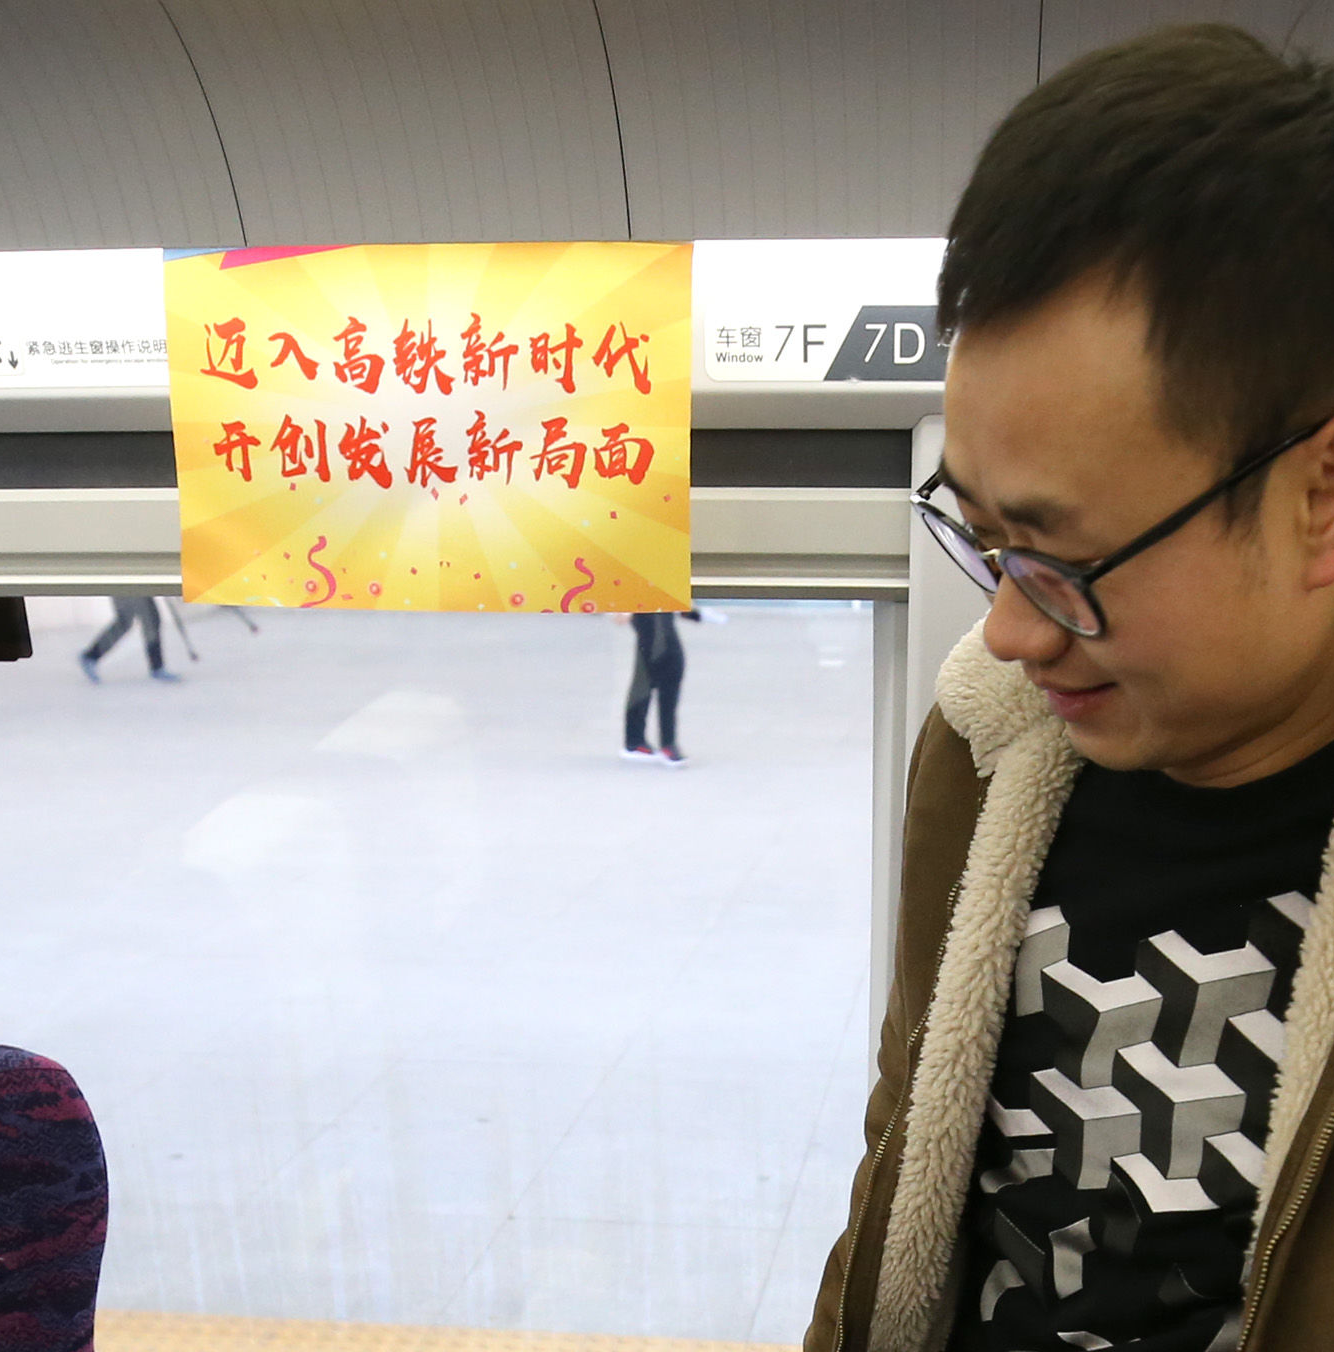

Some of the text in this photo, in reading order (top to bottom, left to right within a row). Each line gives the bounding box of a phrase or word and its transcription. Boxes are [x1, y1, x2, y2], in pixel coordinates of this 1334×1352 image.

[26, 339, 168, 356] 紧急逃生窗操作说明
[716, 326, 762, 348] 车窗
[774, 324, 827, 364] 7F
[864, 322, 926, 365] 7D
[200, 312, 652, 395] 迈入高铁新时代
[715, 352, 764, 363] Window
[213, 410, 654, 490] 开创发展新局面
